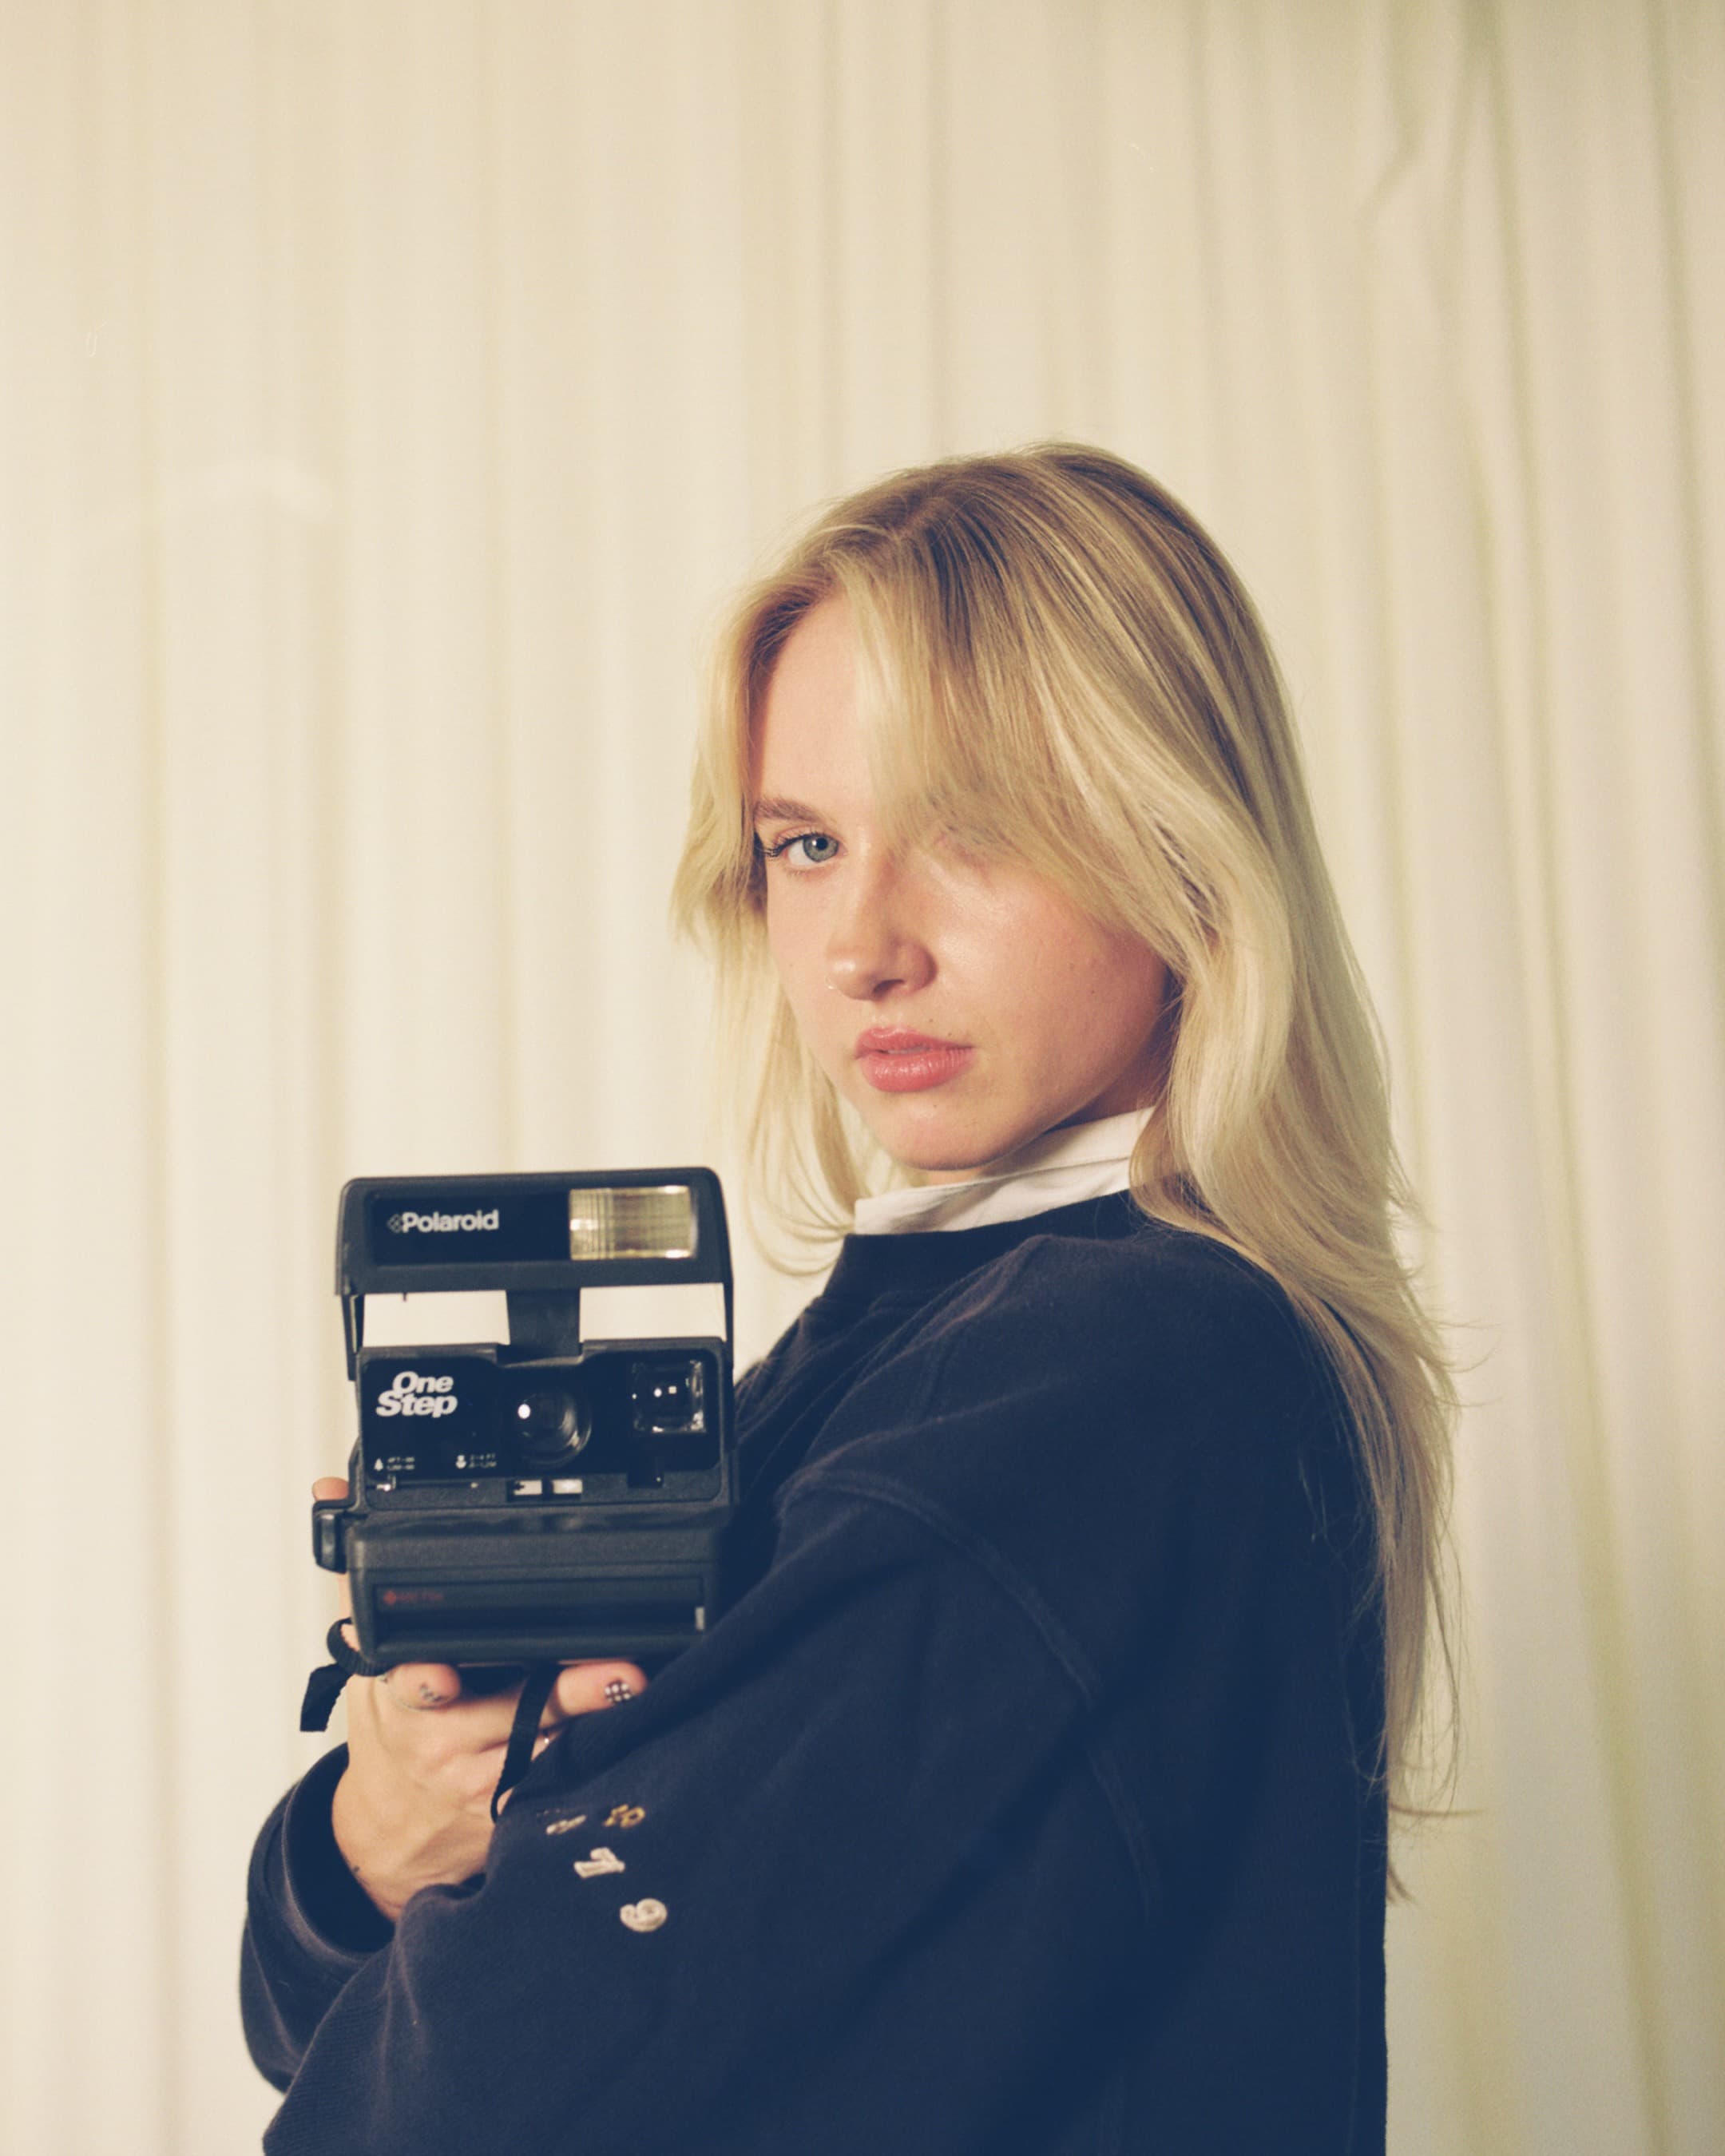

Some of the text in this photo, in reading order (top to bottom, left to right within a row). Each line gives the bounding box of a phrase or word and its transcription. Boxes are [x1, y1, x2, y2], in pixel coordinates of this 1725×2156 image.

[402, 1209, 499, 1233] Polaroid
[392, 1370, 454, 1393] One
[375, 1389, 458, 1418] Step
